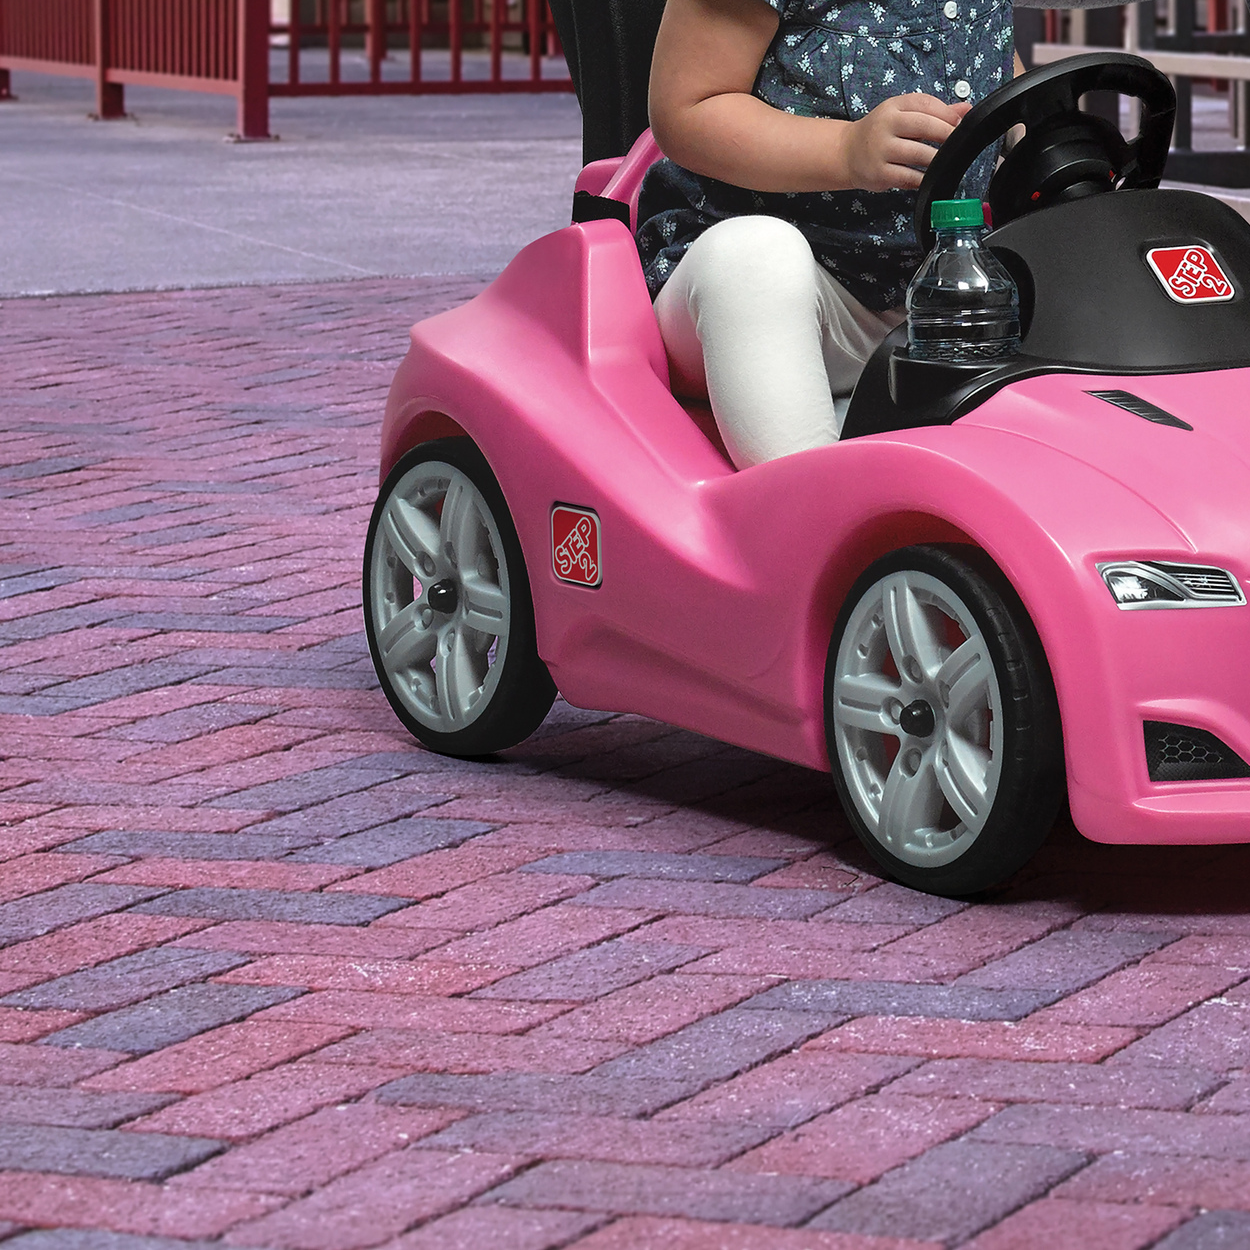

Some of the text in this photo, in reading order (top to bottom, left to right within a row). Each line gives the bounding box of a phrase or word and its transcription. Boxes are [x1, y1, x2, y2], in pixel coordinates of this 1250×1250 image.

[1168, 249, 1207, 297] STEP
[1200, 274, 1228, 296] 2
[555, 517, 591, 574] STEP
[579, 551, 597, 581] 2
